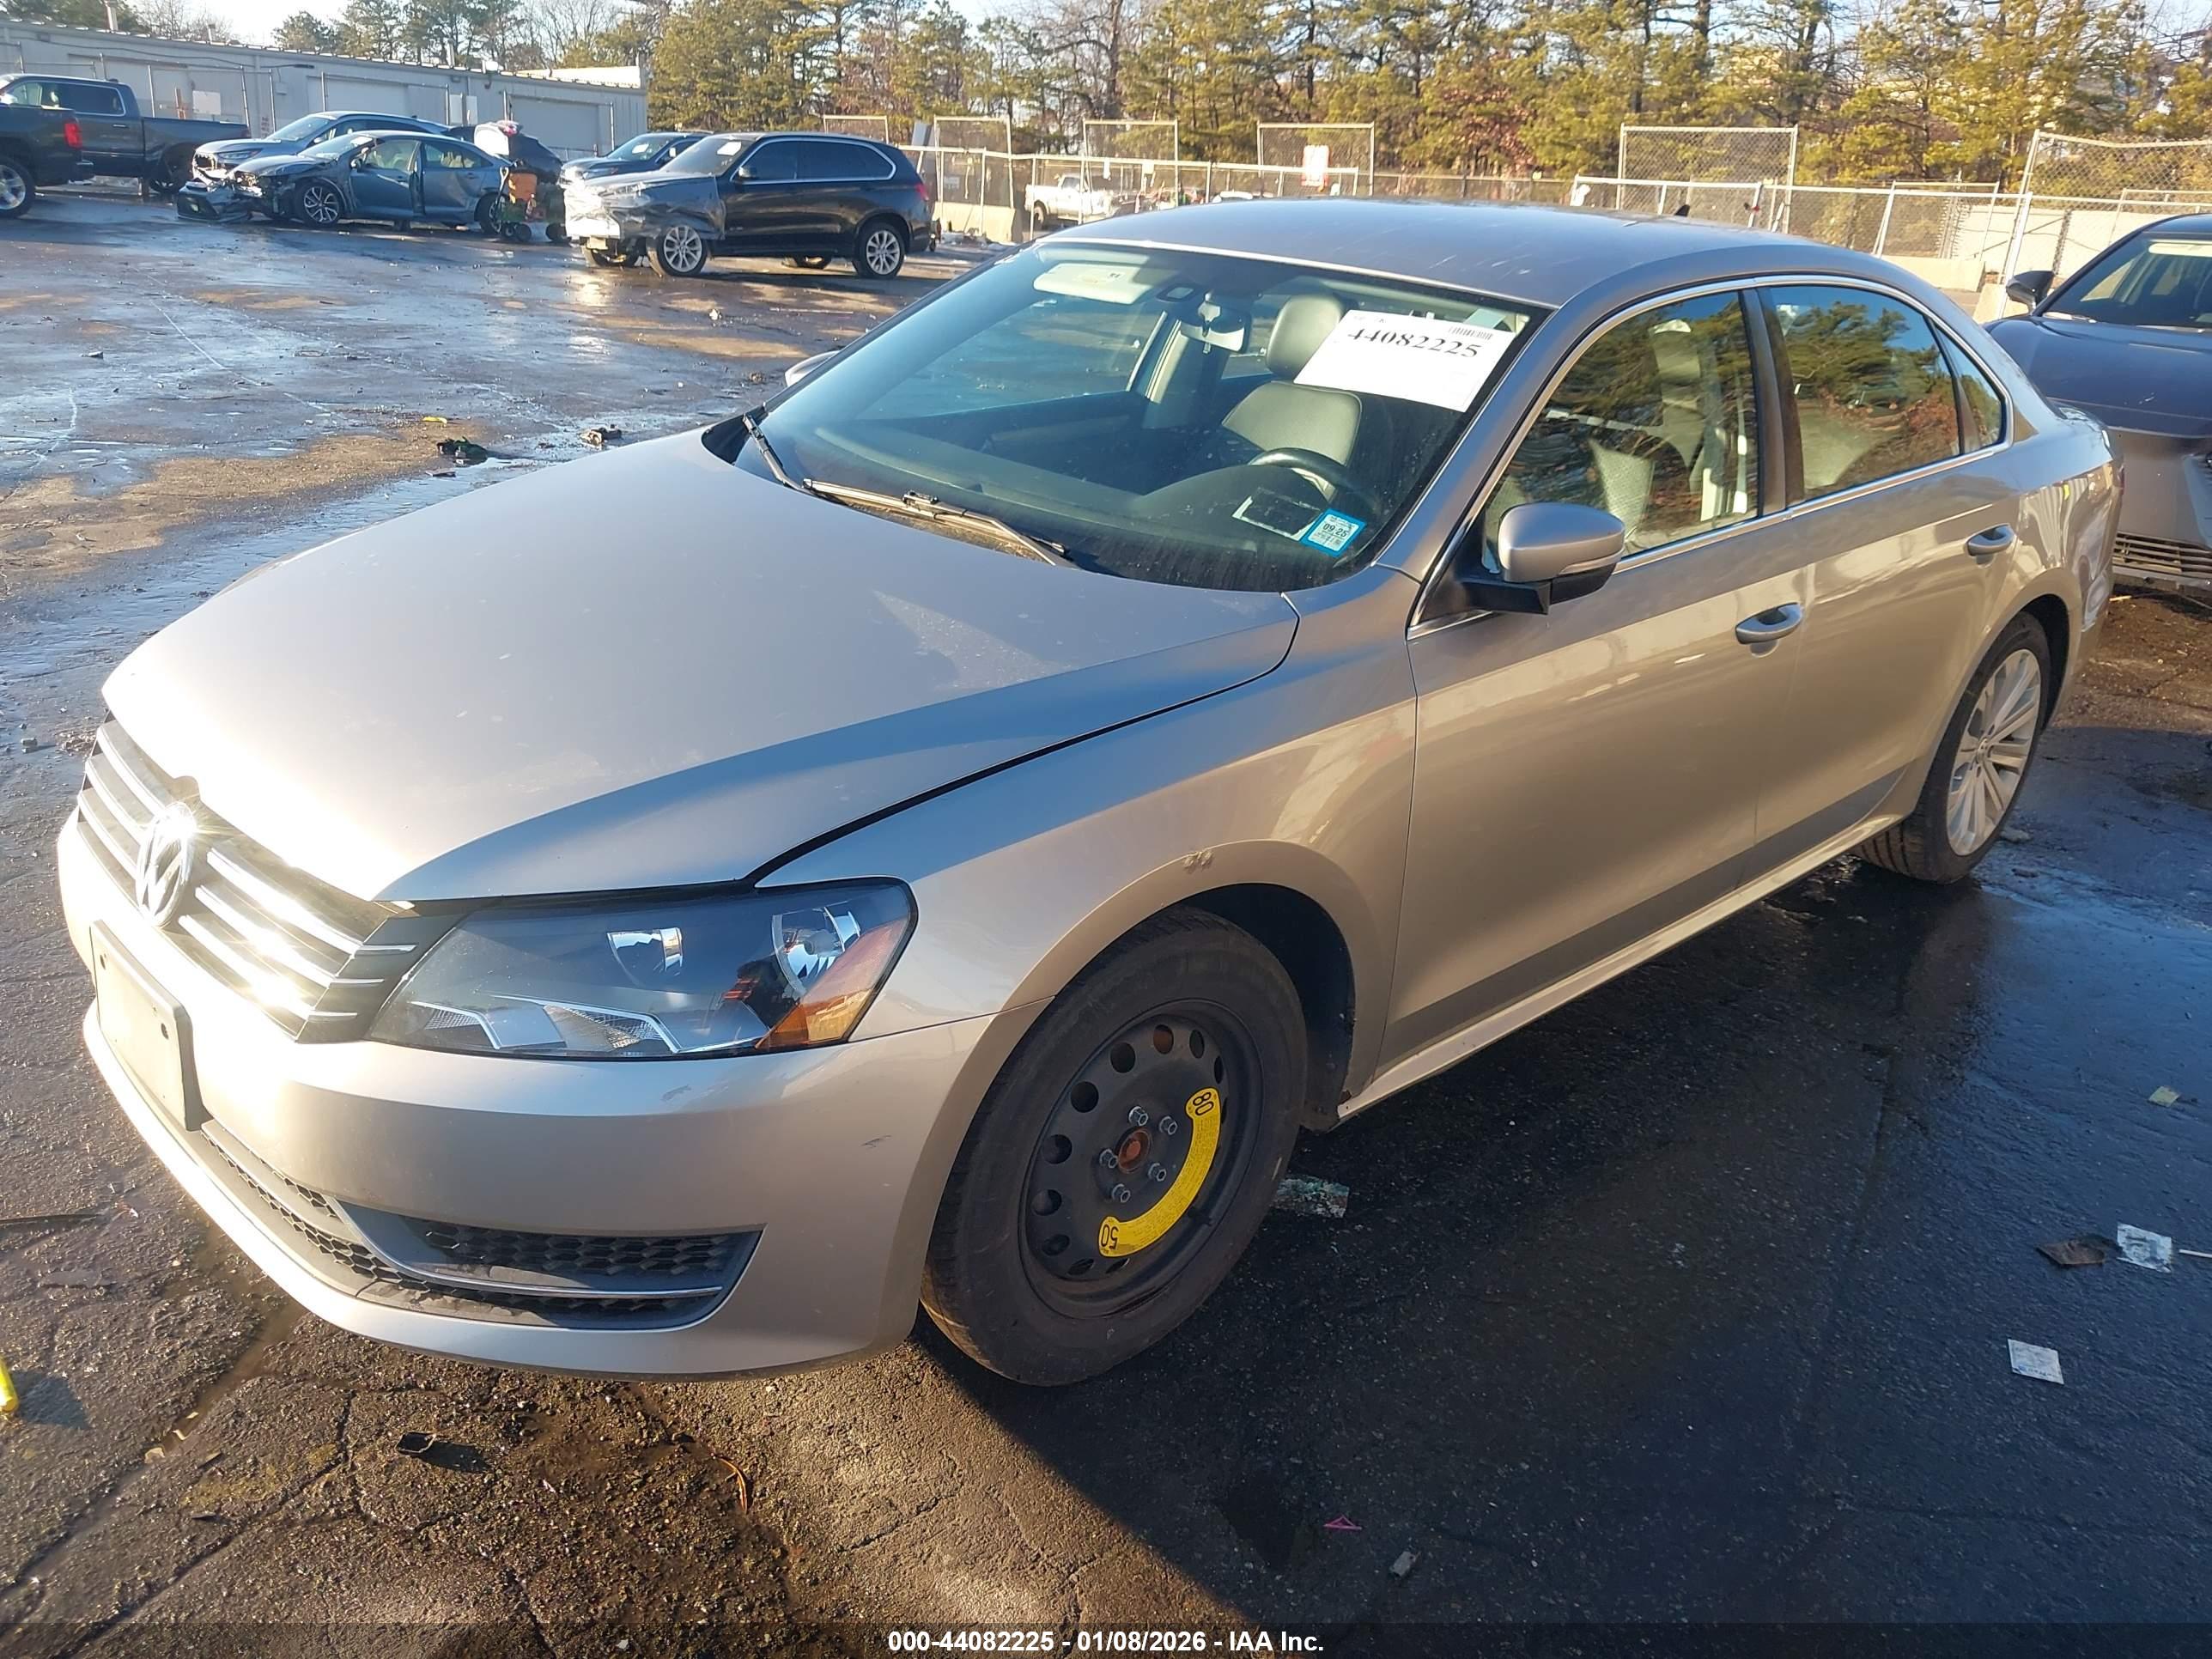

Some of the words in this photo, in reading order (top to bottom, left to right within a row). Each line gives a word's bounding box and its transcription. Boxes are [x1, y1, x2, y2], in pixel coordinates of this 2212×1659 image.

[1347, 327, 1484, 358] 44082225
[1193, 1091, 1214, 1116] 80
[1101, 1224, 1119, 1250] 50
